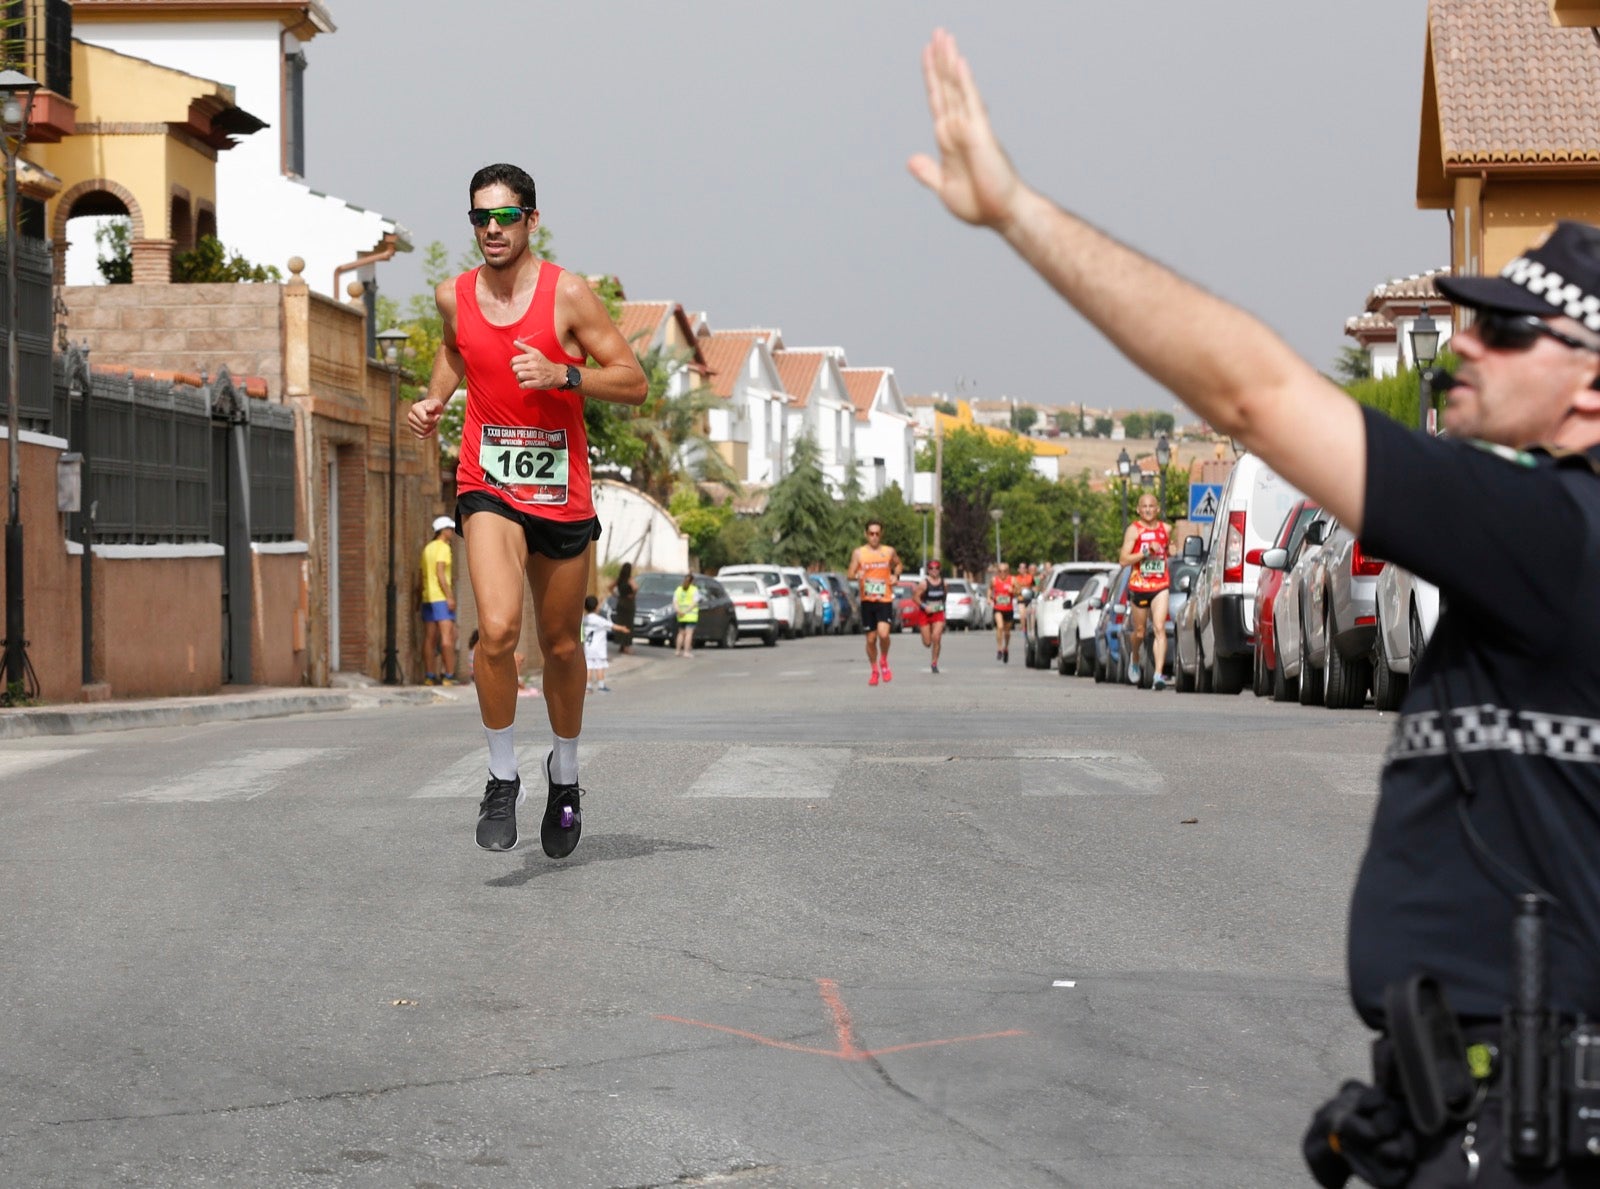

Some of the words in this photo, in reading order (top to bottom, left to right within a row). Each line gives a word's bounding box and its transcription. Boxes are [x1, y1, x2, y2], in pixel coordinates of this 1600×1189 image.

[501, 428, 516, 438] GRAN
[517, 429, 537, 439] PREMIO
[538, 431, 545, 439] DE
[545, 432, 562, 442] FONDO
[498, 450, 555, 479] 162
